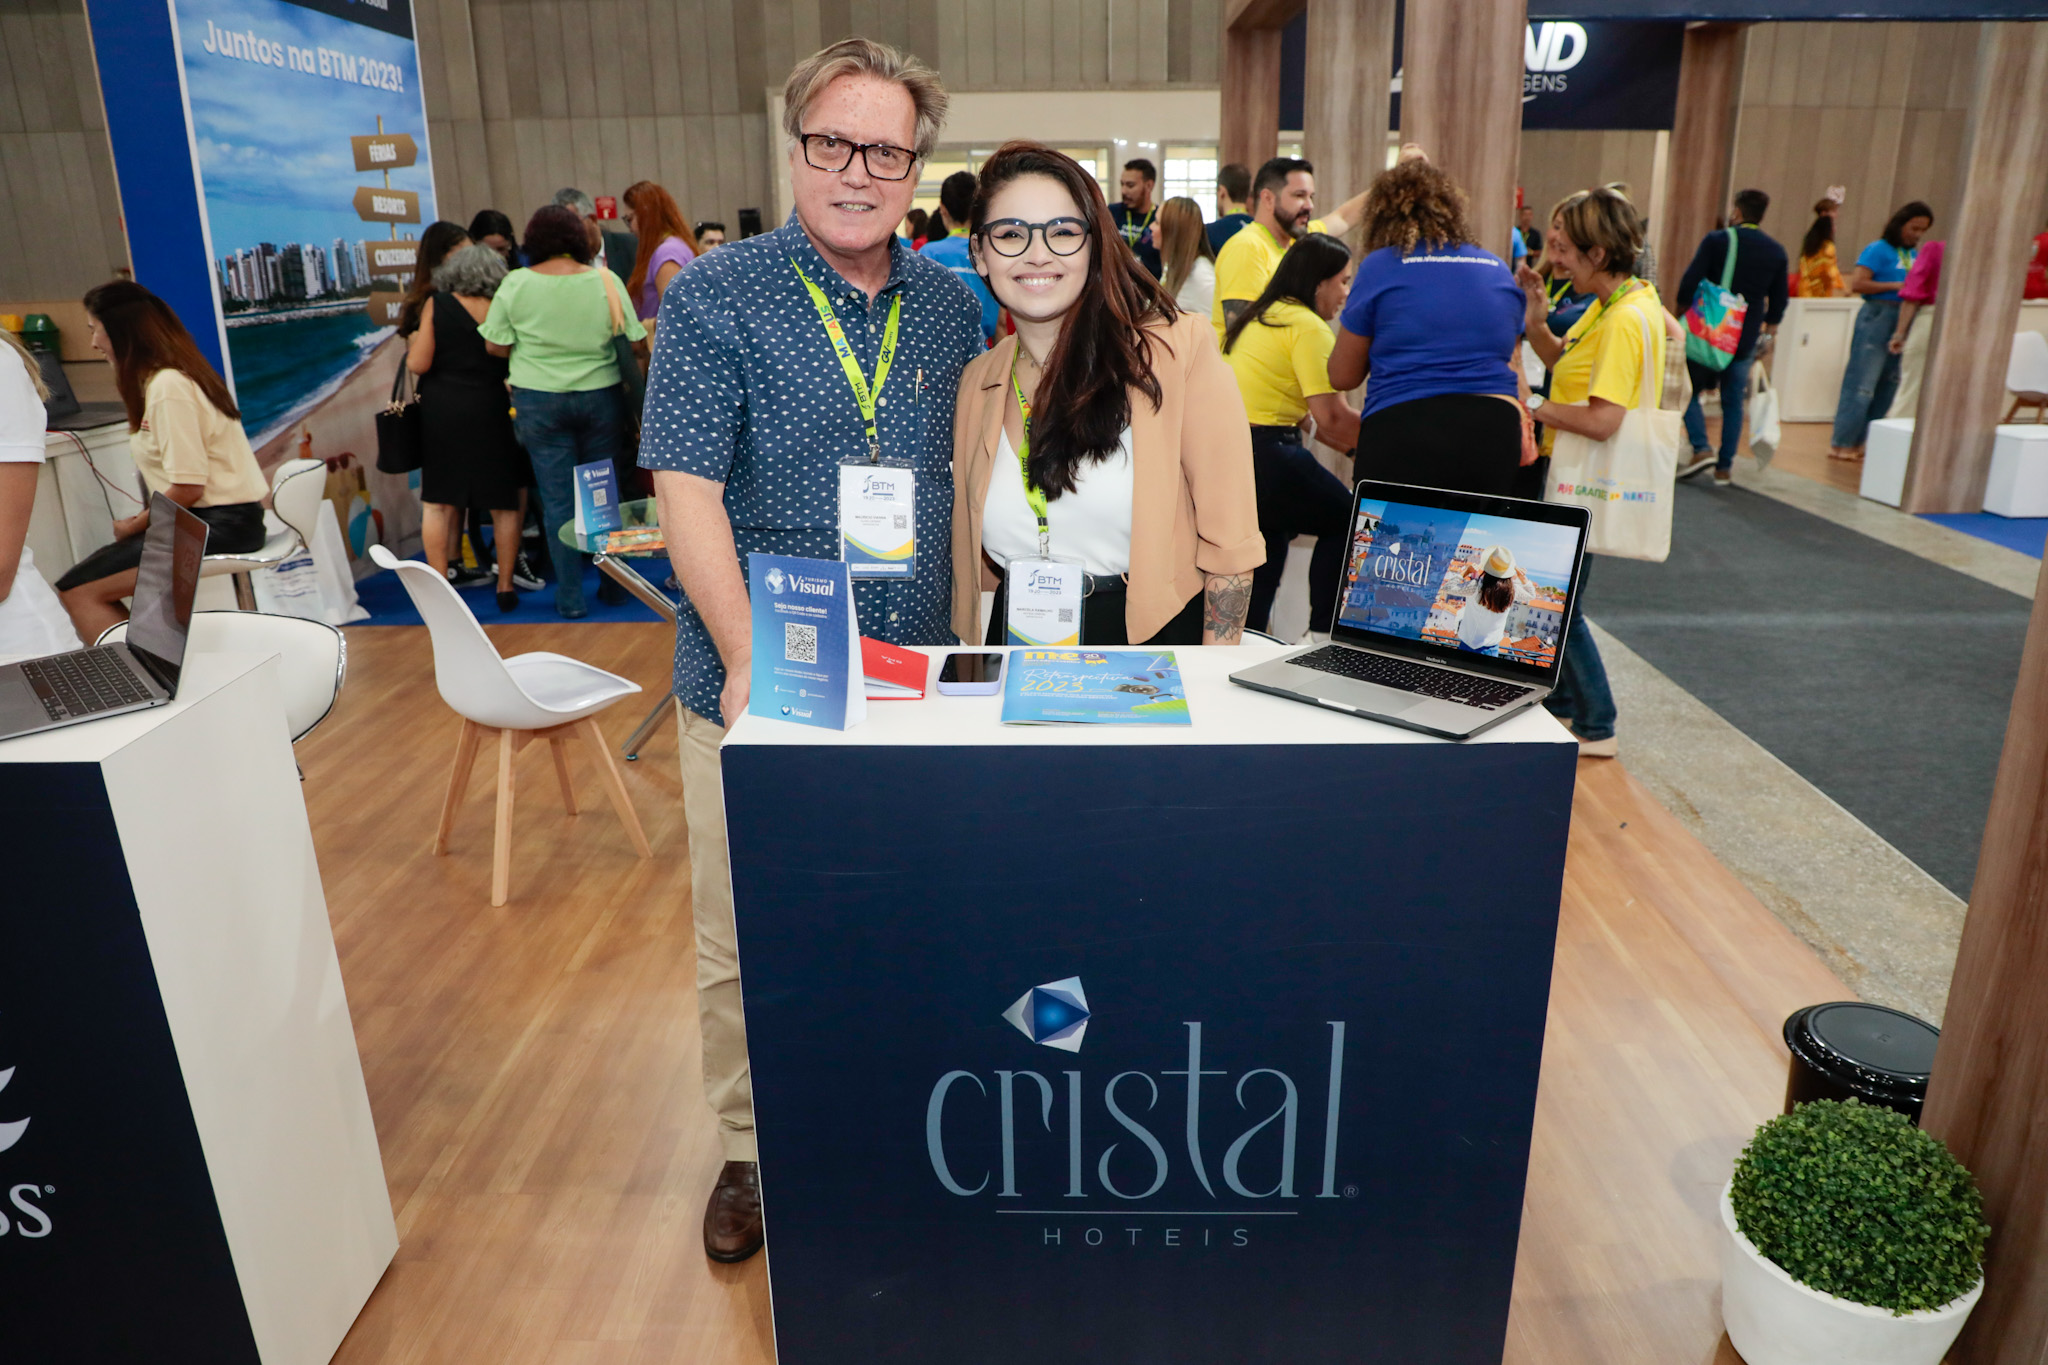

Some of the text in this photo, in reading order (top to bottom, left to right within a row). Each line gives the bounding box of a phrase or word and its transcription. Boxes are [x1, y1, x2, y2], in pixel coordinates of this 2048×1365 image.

[203, 20, 404, 92] Juntos na BTM 2023!
[1524, 21, 1588, 72] ND
[1522, 74, 1568, 92] GENS
[368, 141, 397, 163] FÉRIAS
[372, 196, 407, 215] RESORTS
[374, 248, 416, 267] CRUZEIROS
[820, 305, 851, 359] MANAUS
[854, 383, 867, 403] BTM
[872, 481, 895, 490] BTM
[1557, 483, 1575, 495] RIO
[1374, 552, 1432, 585] cristal
[788, 573, 834, 597] Visual
[805, 576, 828, 584] TURISMO
[1038, 575, 1062, 585] BTM
[774, 602, 787, 610] Seja
[787, 604, 805, 612] nosso
[1023, 668, 1135, 684] Retrospectiva
[1020, 680, 1085, 693] 2023
[791, 707, 813, 718] Visual
[926, 1020, 1346, 1199] cristal
[1043, 1227, 1249, 1248] HOTEIS
